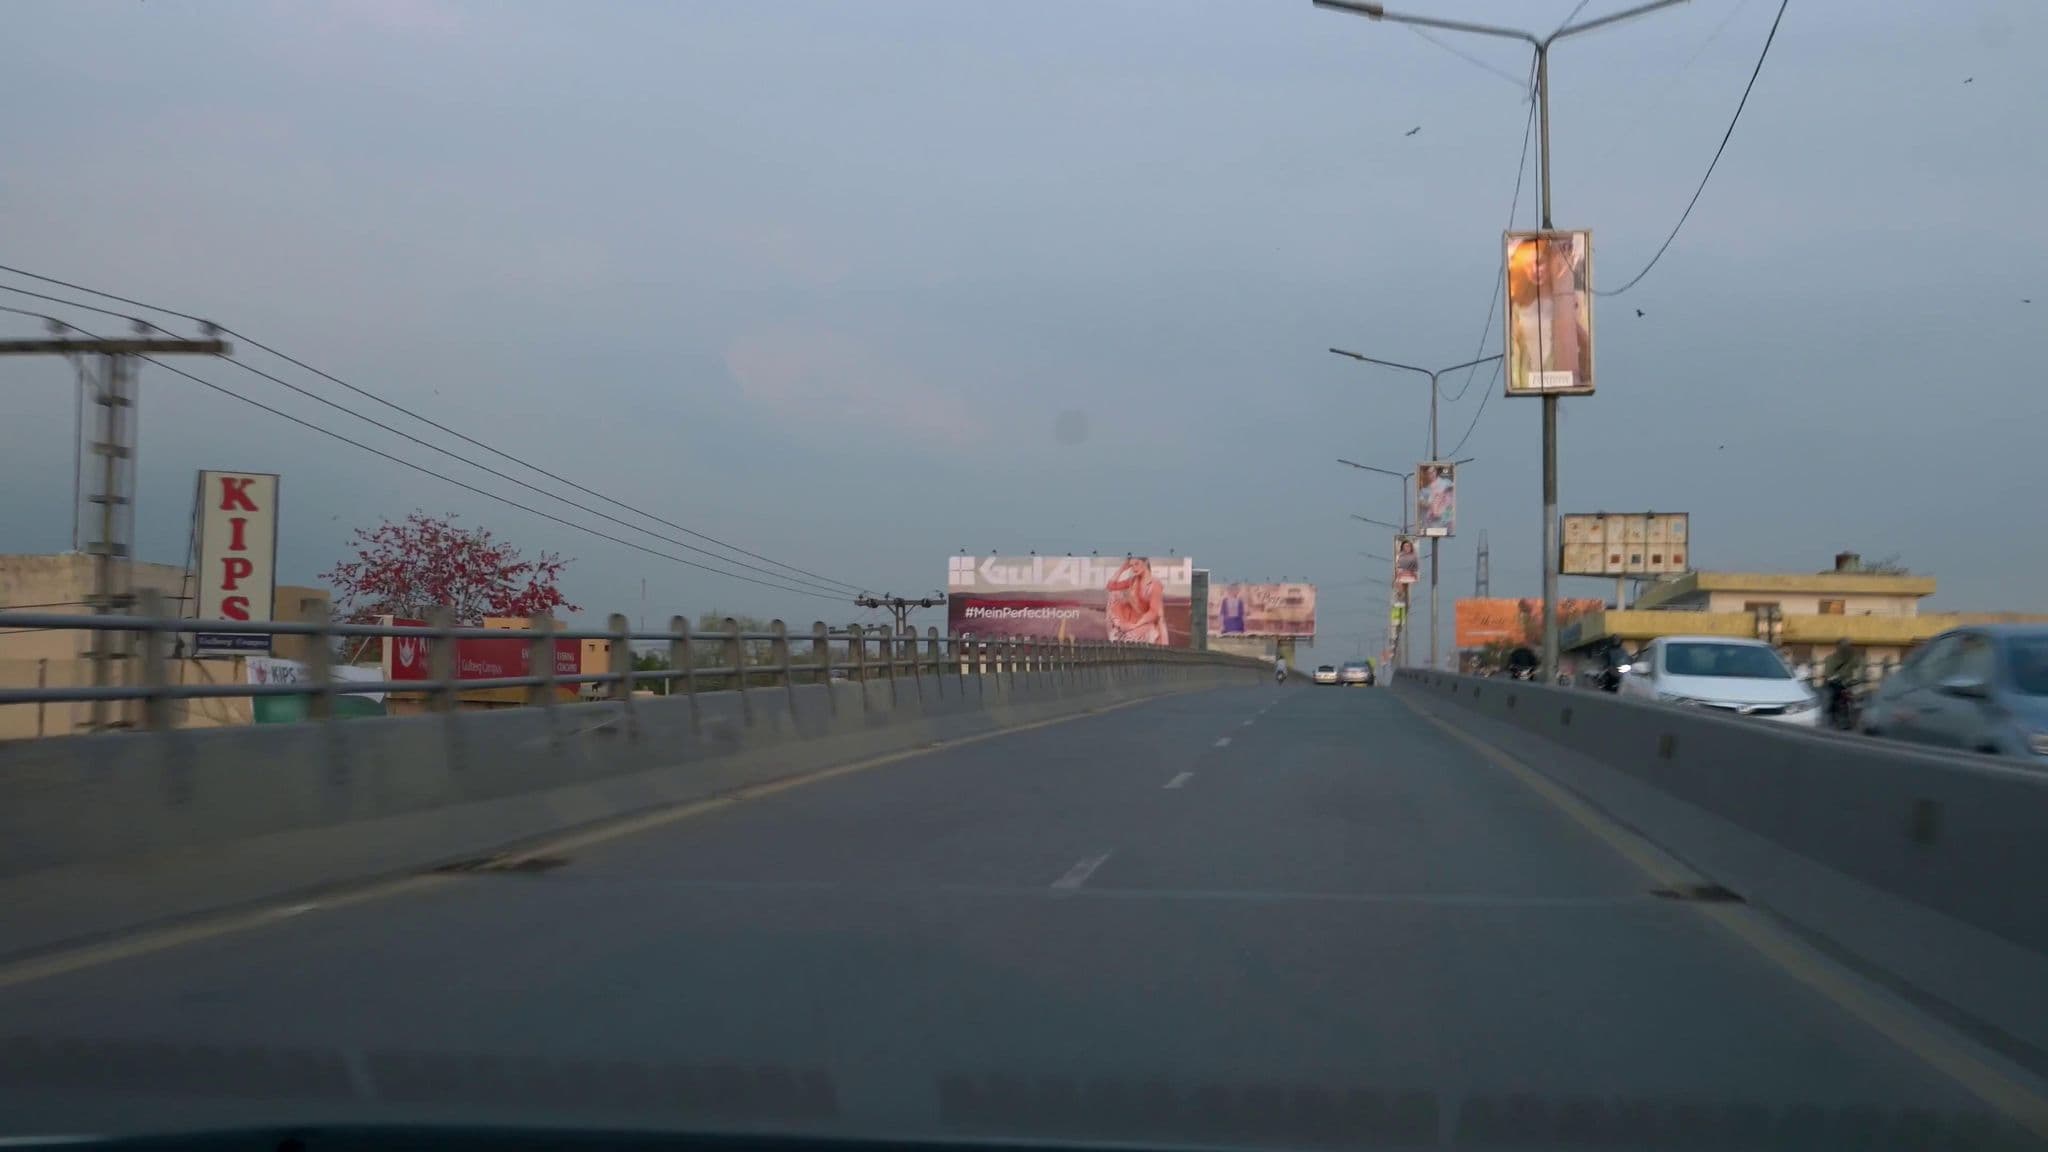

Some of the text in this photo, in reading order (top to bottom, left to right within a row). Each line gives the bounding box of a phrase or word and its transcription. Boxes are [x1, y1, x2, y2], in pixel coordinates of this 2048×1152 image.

[219, 477, 259, 621] KIPS
[979, 556, 1043, 584] Gul
[964, 606, 1081, 620] #MeinPerfectHoon
